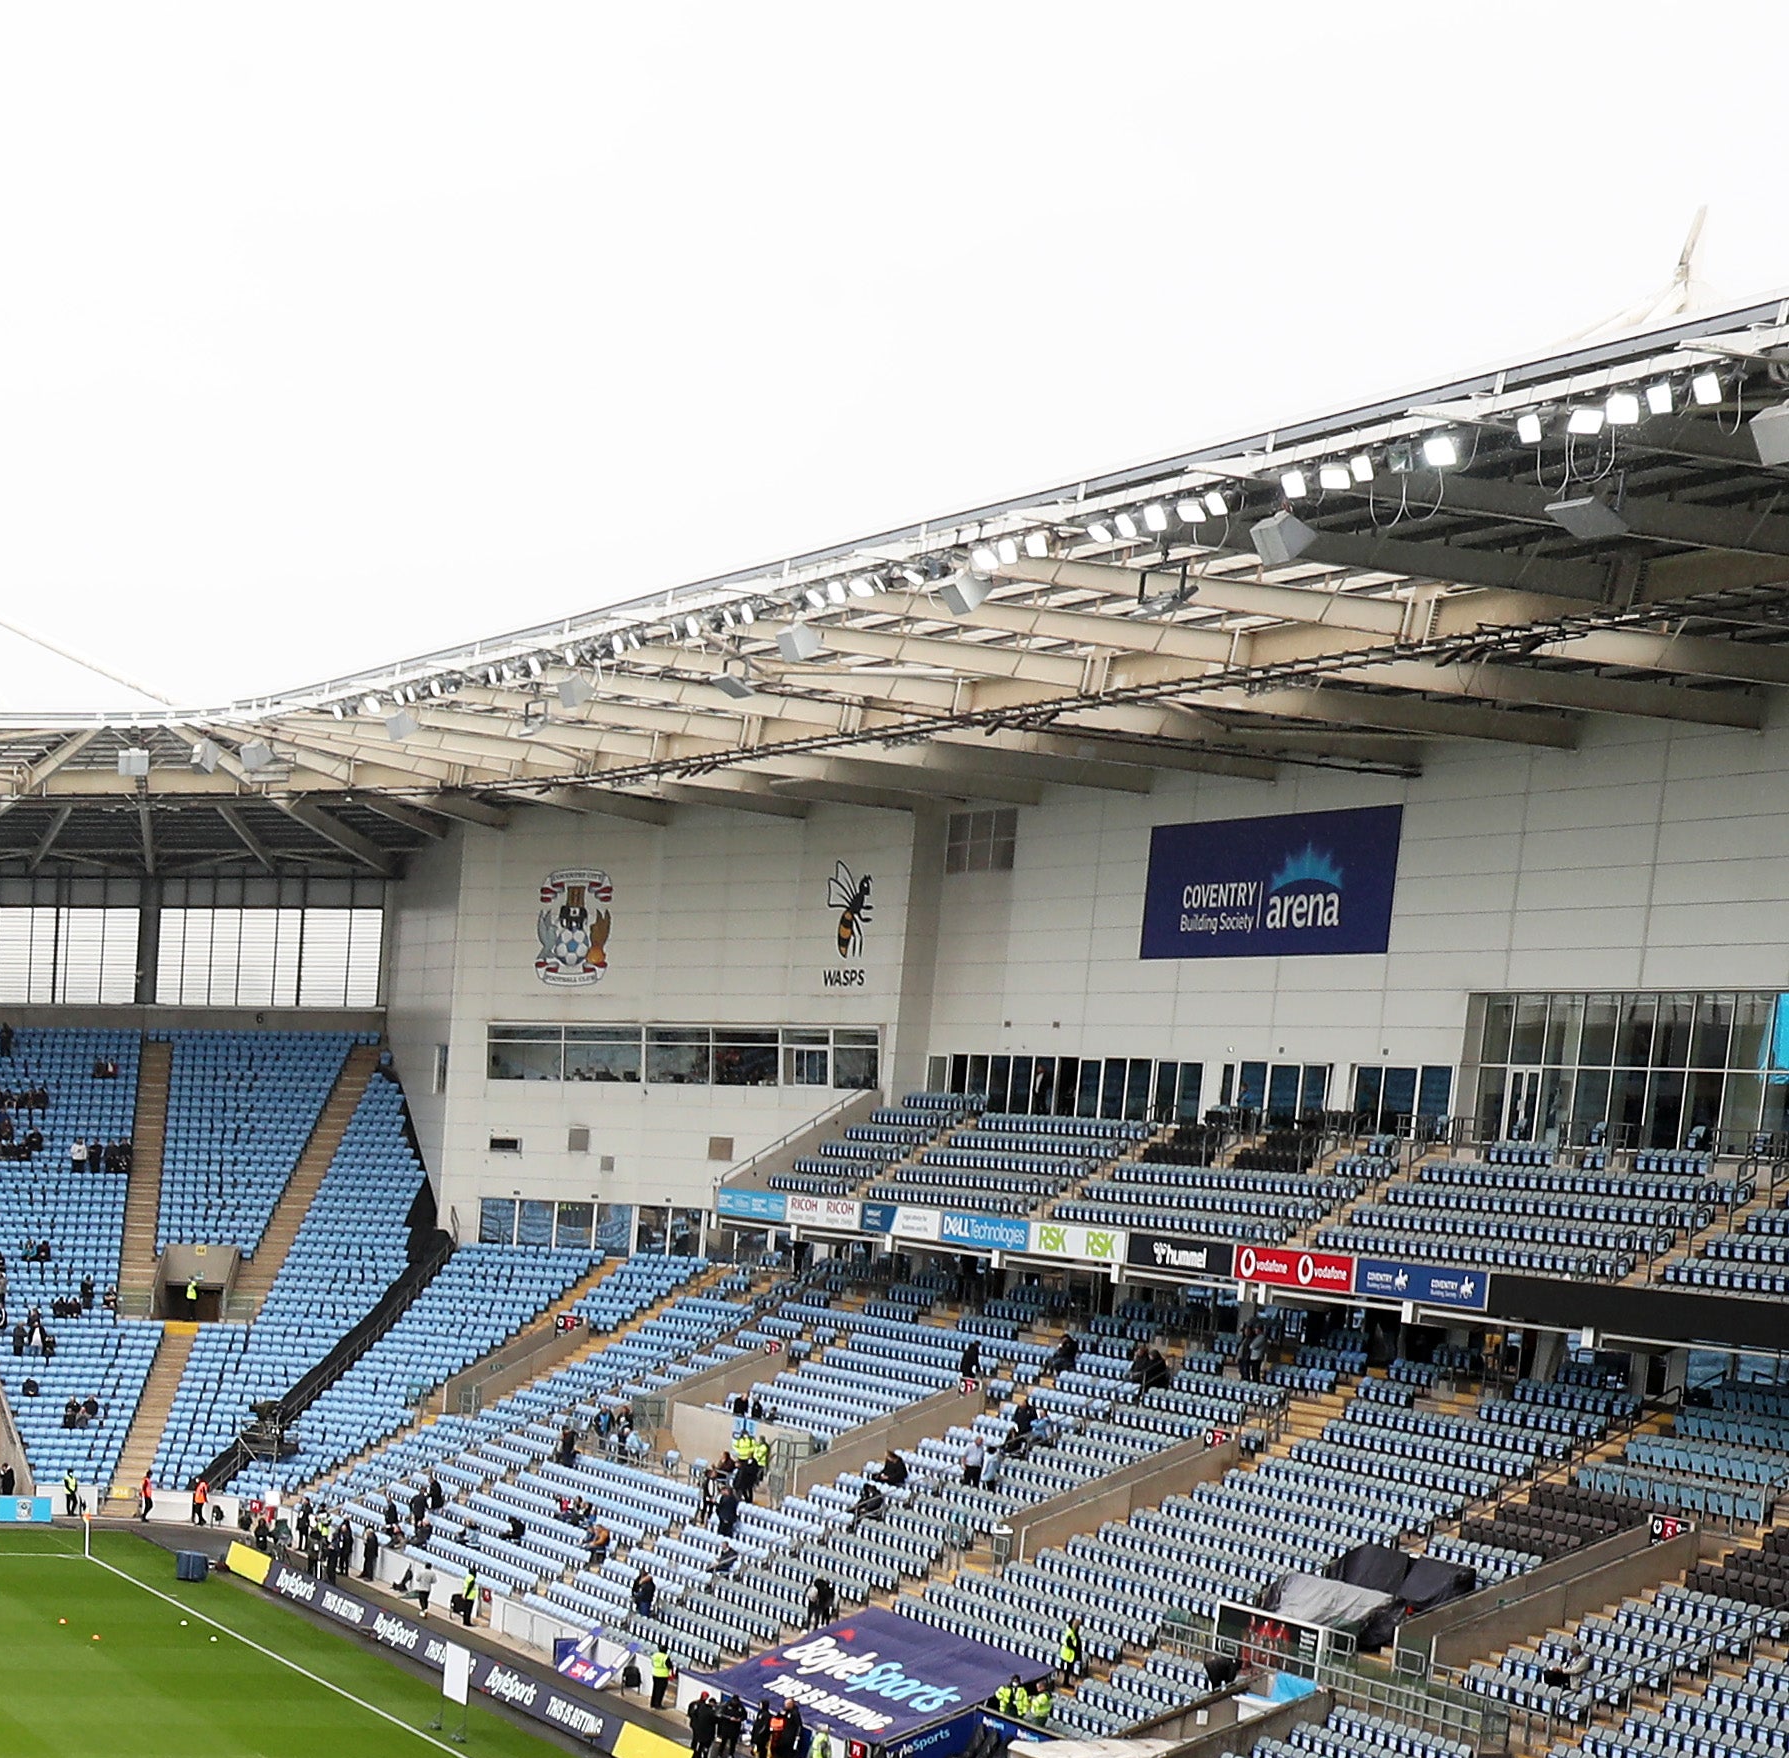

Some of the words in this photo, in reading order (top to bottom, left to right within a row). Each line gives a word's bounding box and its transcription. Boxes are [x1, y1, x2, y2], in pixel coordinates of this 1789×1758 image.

[1182, 881, 1258, 909] COVENTRY
[1266, 891, 1339, 929] arena
[1180, 913, 1219, 935] Building
[1219, 911, 1254, 934] Society
[823, 969, 865, 987] WASPS
[791, 1196, 818, 1212] RICOH
[826, 1200, 854, 1216] RICOH
[1039, 1225, 1067, 1252] RSK
[1085, 1231, 1116, 1258] RSK
[1165, 1244, 1206, 1269] hummel
[1256, 1259, 1288, 1275] vodafone
[1314, 1266, 1347, 1281] vodafone
[276, 1568, 317, 1601] BoyleSports
[373, 1613, 419, 1649] BoyleSports
[484, 1665, 538, 1705] BoyleSports
[782, 1634, 963, 1713] BoyleSports
[763, 1674, 811, 1703] THIS
[802, 1689, 821, 1707] IS
[545, 1695, 563, 1718] THIS
[562, 1705, 572, 1725] IS
